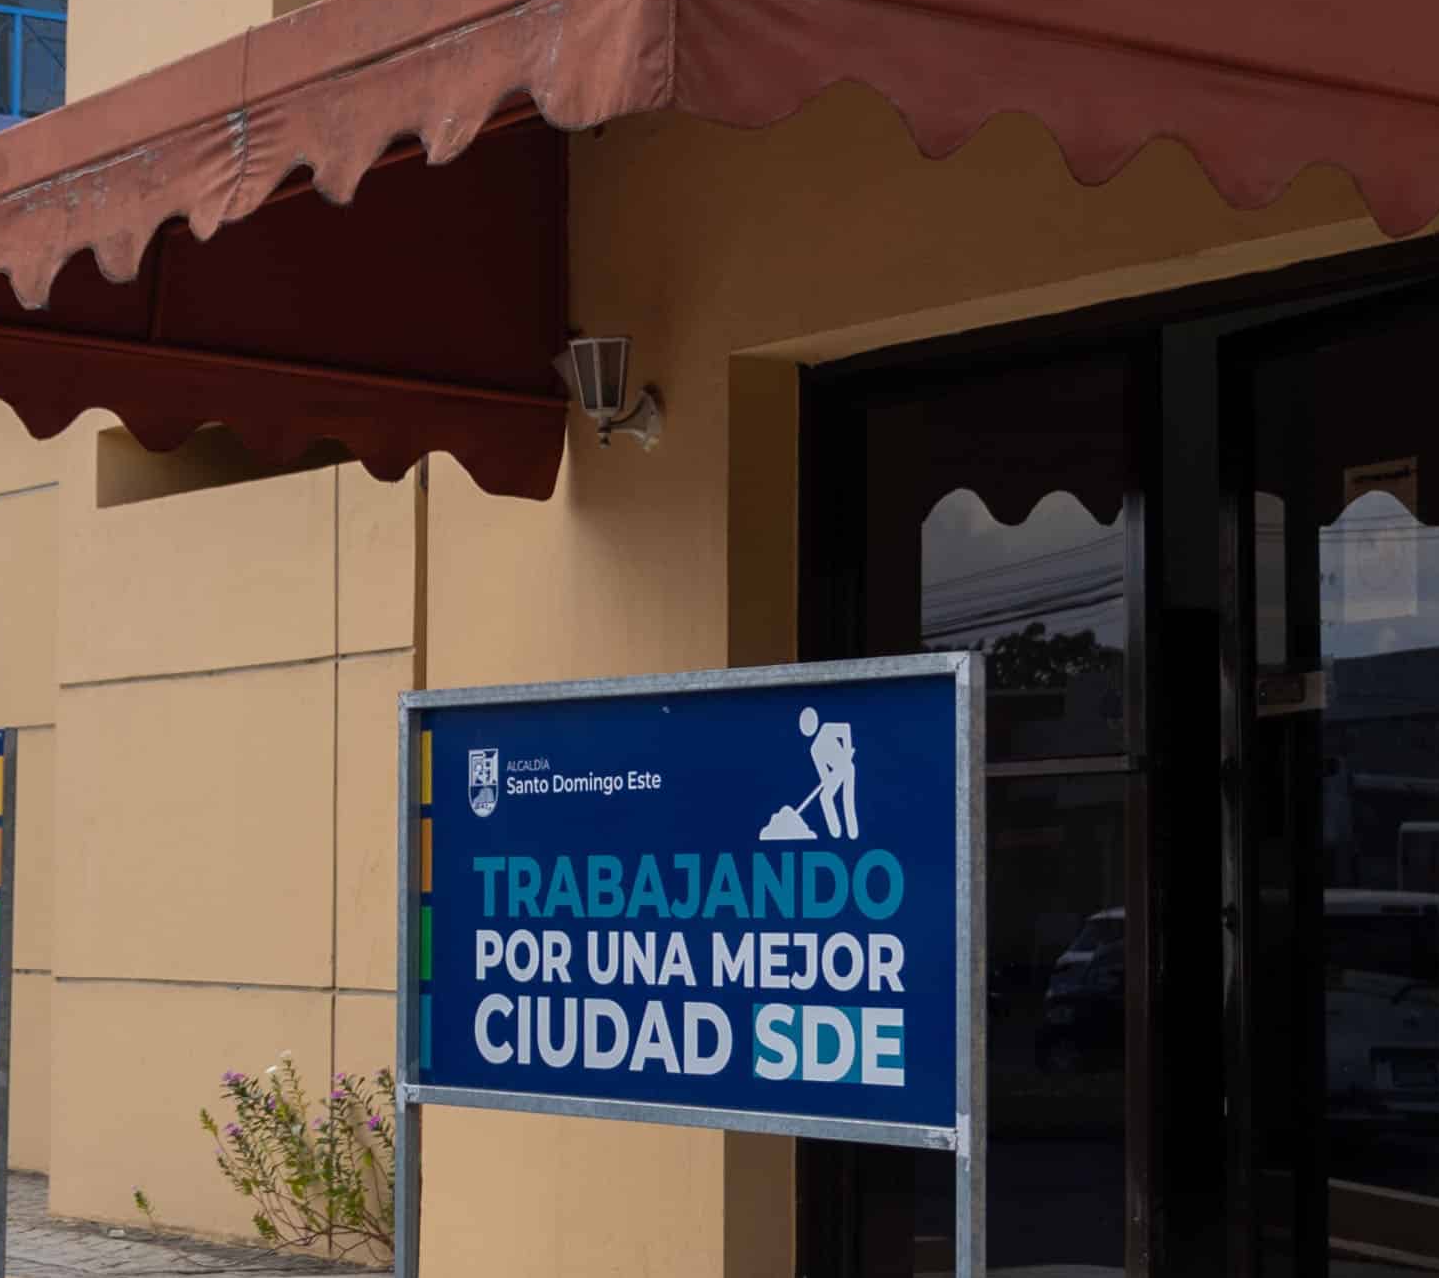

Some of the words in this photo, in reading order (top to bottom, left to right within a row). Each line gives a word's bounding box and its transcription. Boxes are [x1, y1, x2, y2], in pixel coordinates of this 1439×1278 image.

[506, 757, 550, 772] ALCALDÍA
[506, 776, 549, 795] Santo
[552, 771, 623, 796] Domingo
[627, 770, 662, 790] Este
[473, 848, 905, 921] TRABAJANDO
[475, 928, 572, 984] POR
[587, 930, 697, 987] UNA
[711, 932, 906, 993] MEJOR
[473, 992, 733, 1076] CIUDAD
[754, 1002, 906, 1088] SDE
